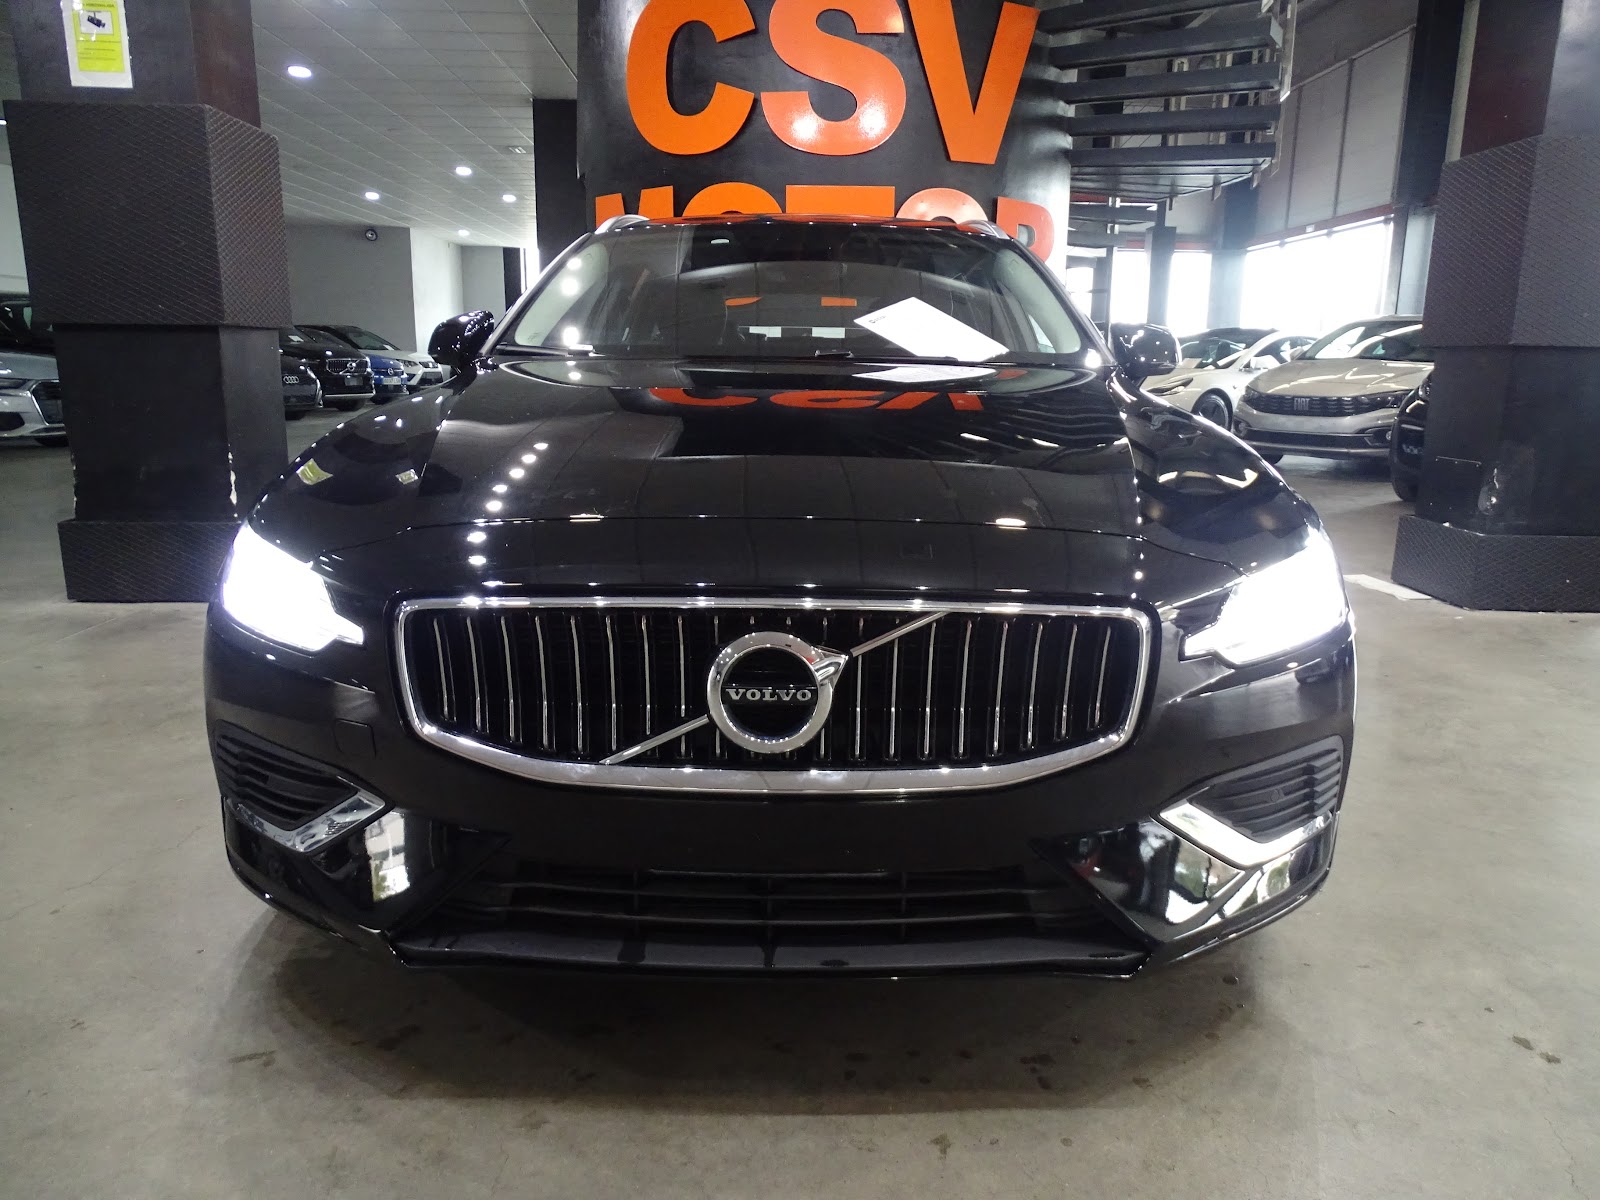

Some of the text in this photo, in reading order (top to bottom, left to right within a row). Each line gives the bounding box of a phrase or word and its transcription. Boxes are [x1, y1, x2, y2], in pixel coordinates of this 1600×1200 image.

[626, 0, 1040, 165] CSV
[1293, 397, 1310, 411] FIAT
[726, 689, 812, 701] VOLVO
